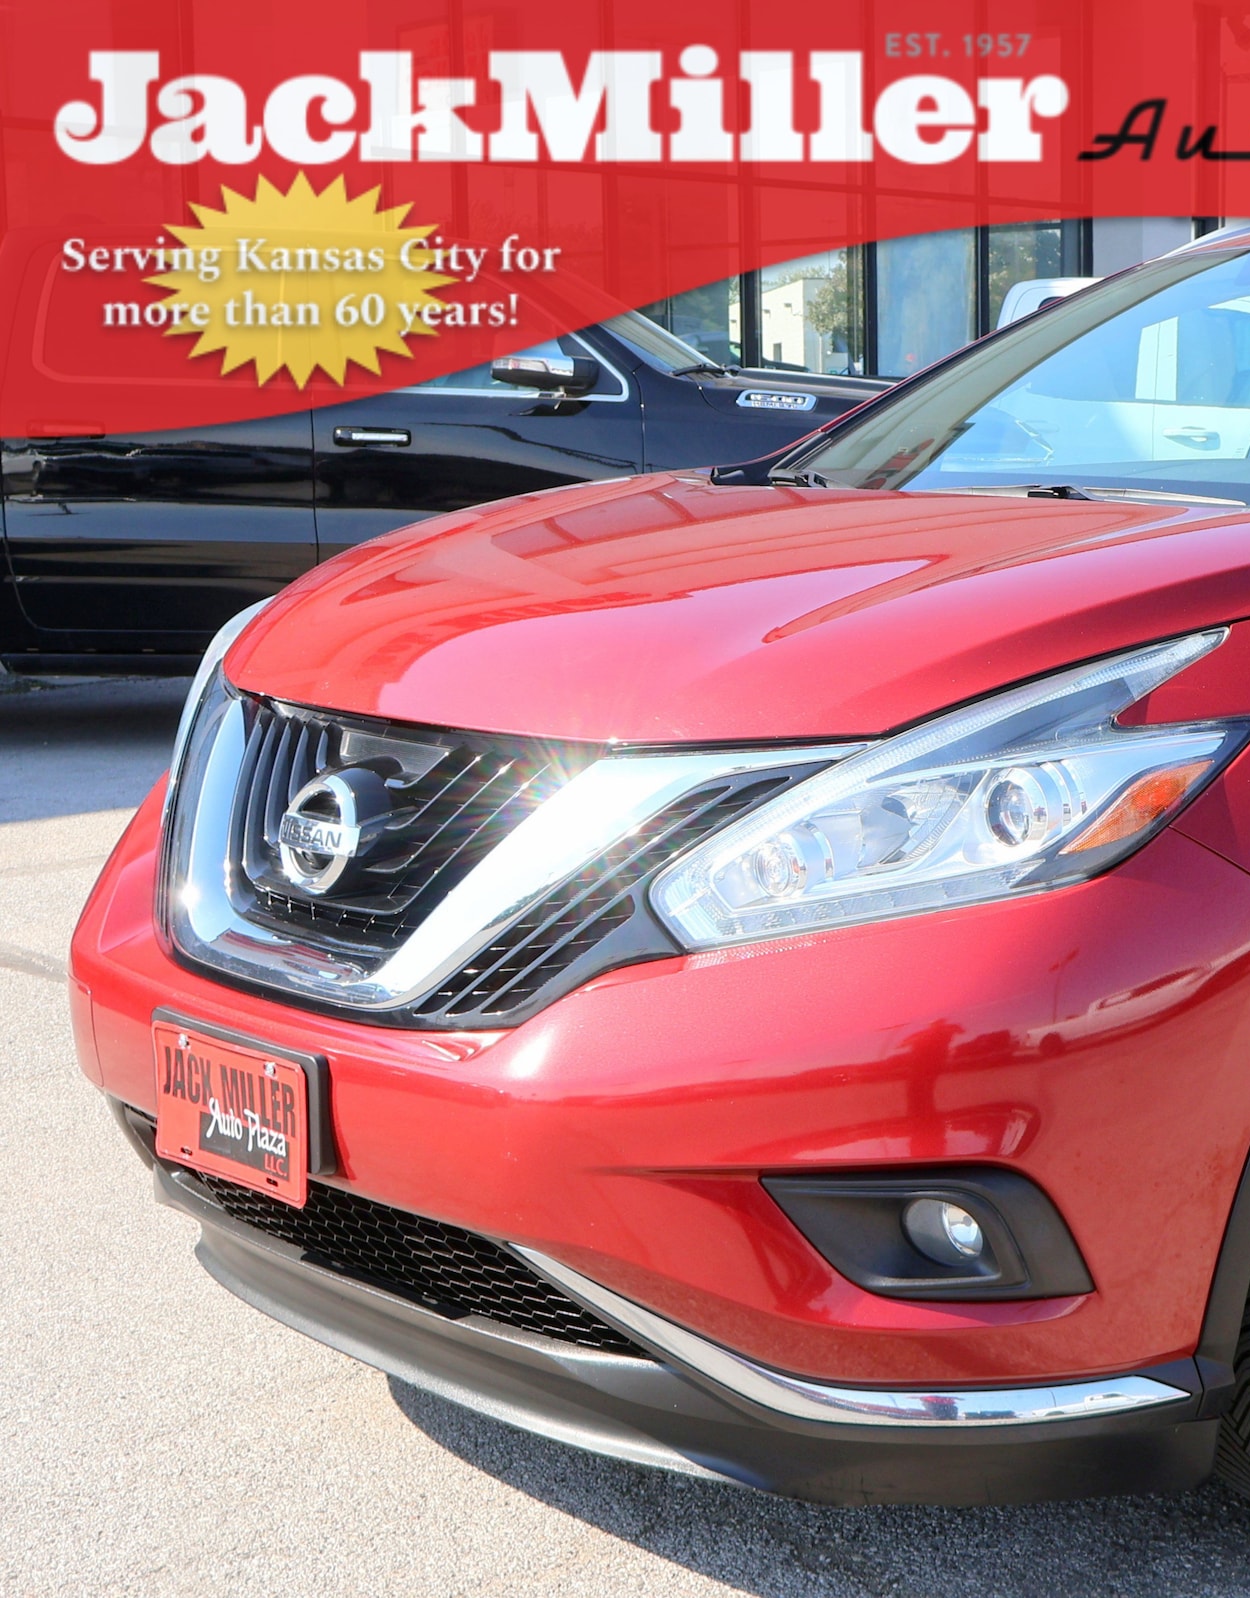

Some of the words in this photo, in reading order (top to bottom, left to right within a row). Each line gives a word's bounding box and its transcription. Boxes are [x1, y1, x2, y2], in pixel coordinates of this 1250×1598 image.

[280, 816, 343, 850] NISSAN
[162, 1045, 213, 1107] JACK
[218, 1062, 297, 1140] MILLER
[206, 1096, 243, 1141] Auto
[243, 1107, 287, 1159] Plaza
